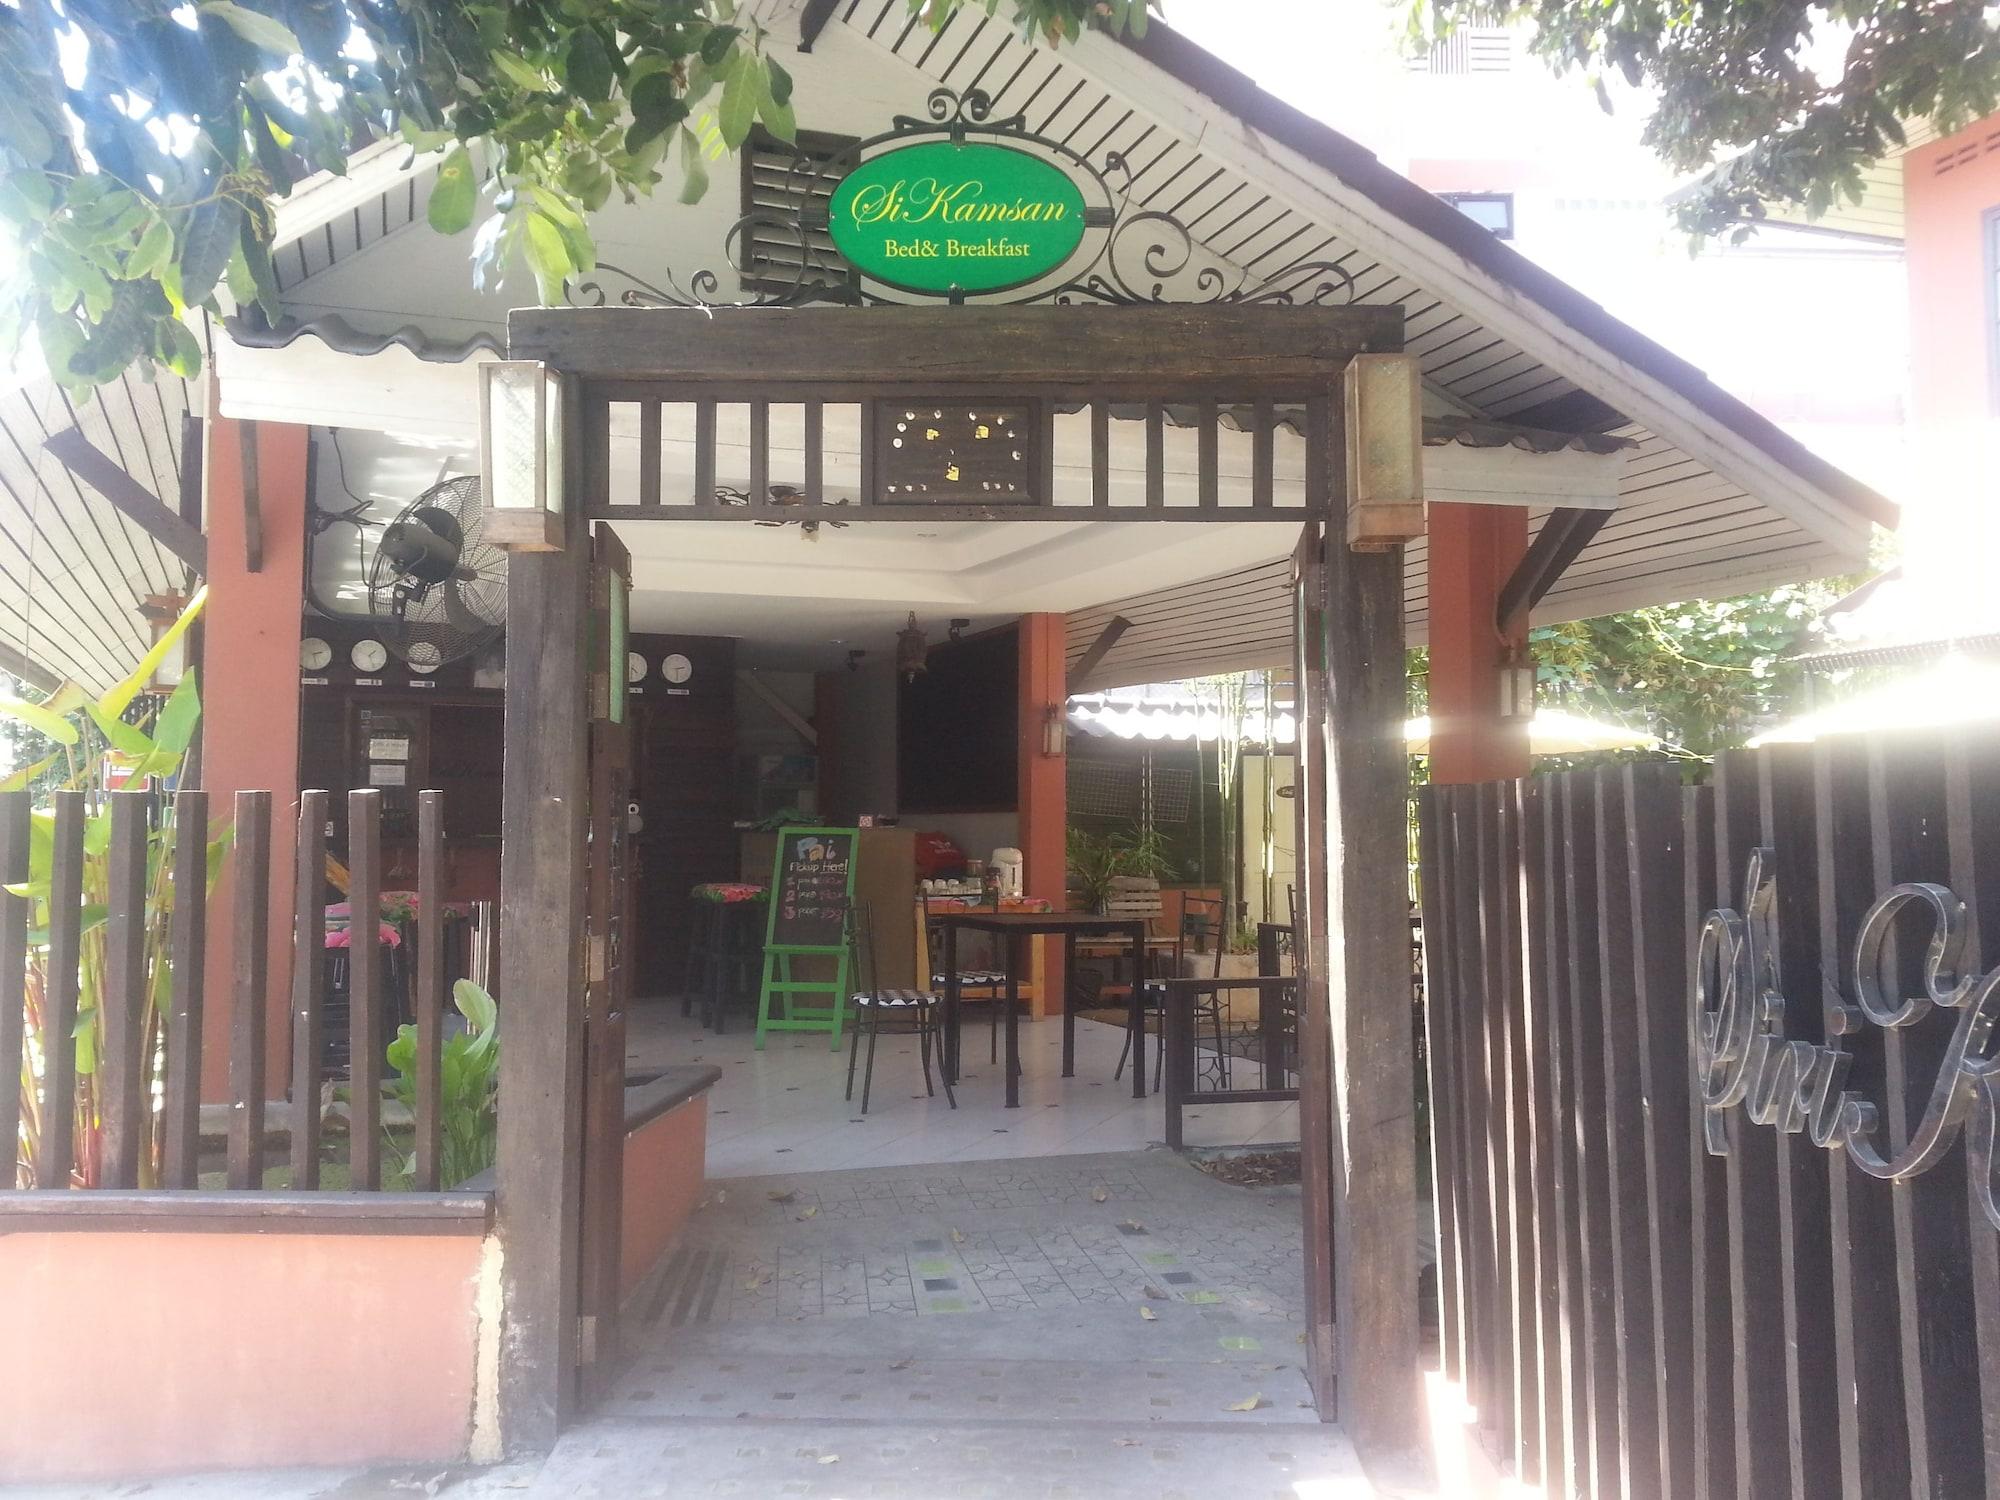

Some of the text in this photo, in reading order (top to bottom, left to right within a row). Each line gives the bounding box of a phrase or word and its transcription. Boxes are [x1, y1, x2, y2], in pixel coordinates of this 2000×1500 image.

[851, 177, 1069, 231] Si Kamsan
[884, 238, 1030, 258] Bed& Breakfast
